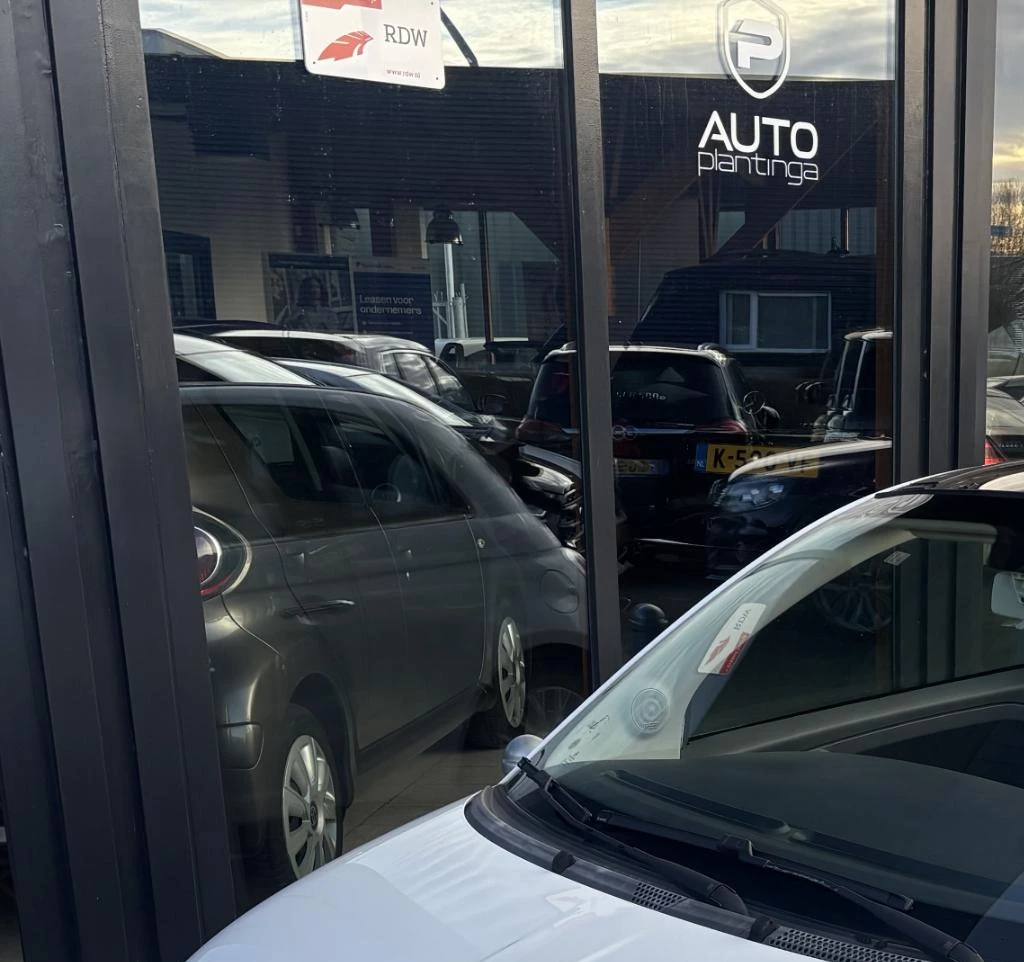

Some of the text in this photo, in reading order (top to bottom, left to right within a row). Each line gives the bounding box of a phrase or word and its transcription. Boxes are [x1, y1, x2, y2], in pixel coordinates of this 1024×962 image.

[383, 23, 428, 48] RDW
[698, 110, 818, 159] AUTO
[698, 148, 819, 186] plantinga
[359, 294, 414, 305] Leasen voor
[360, 305, 422, 315] ondernemers
